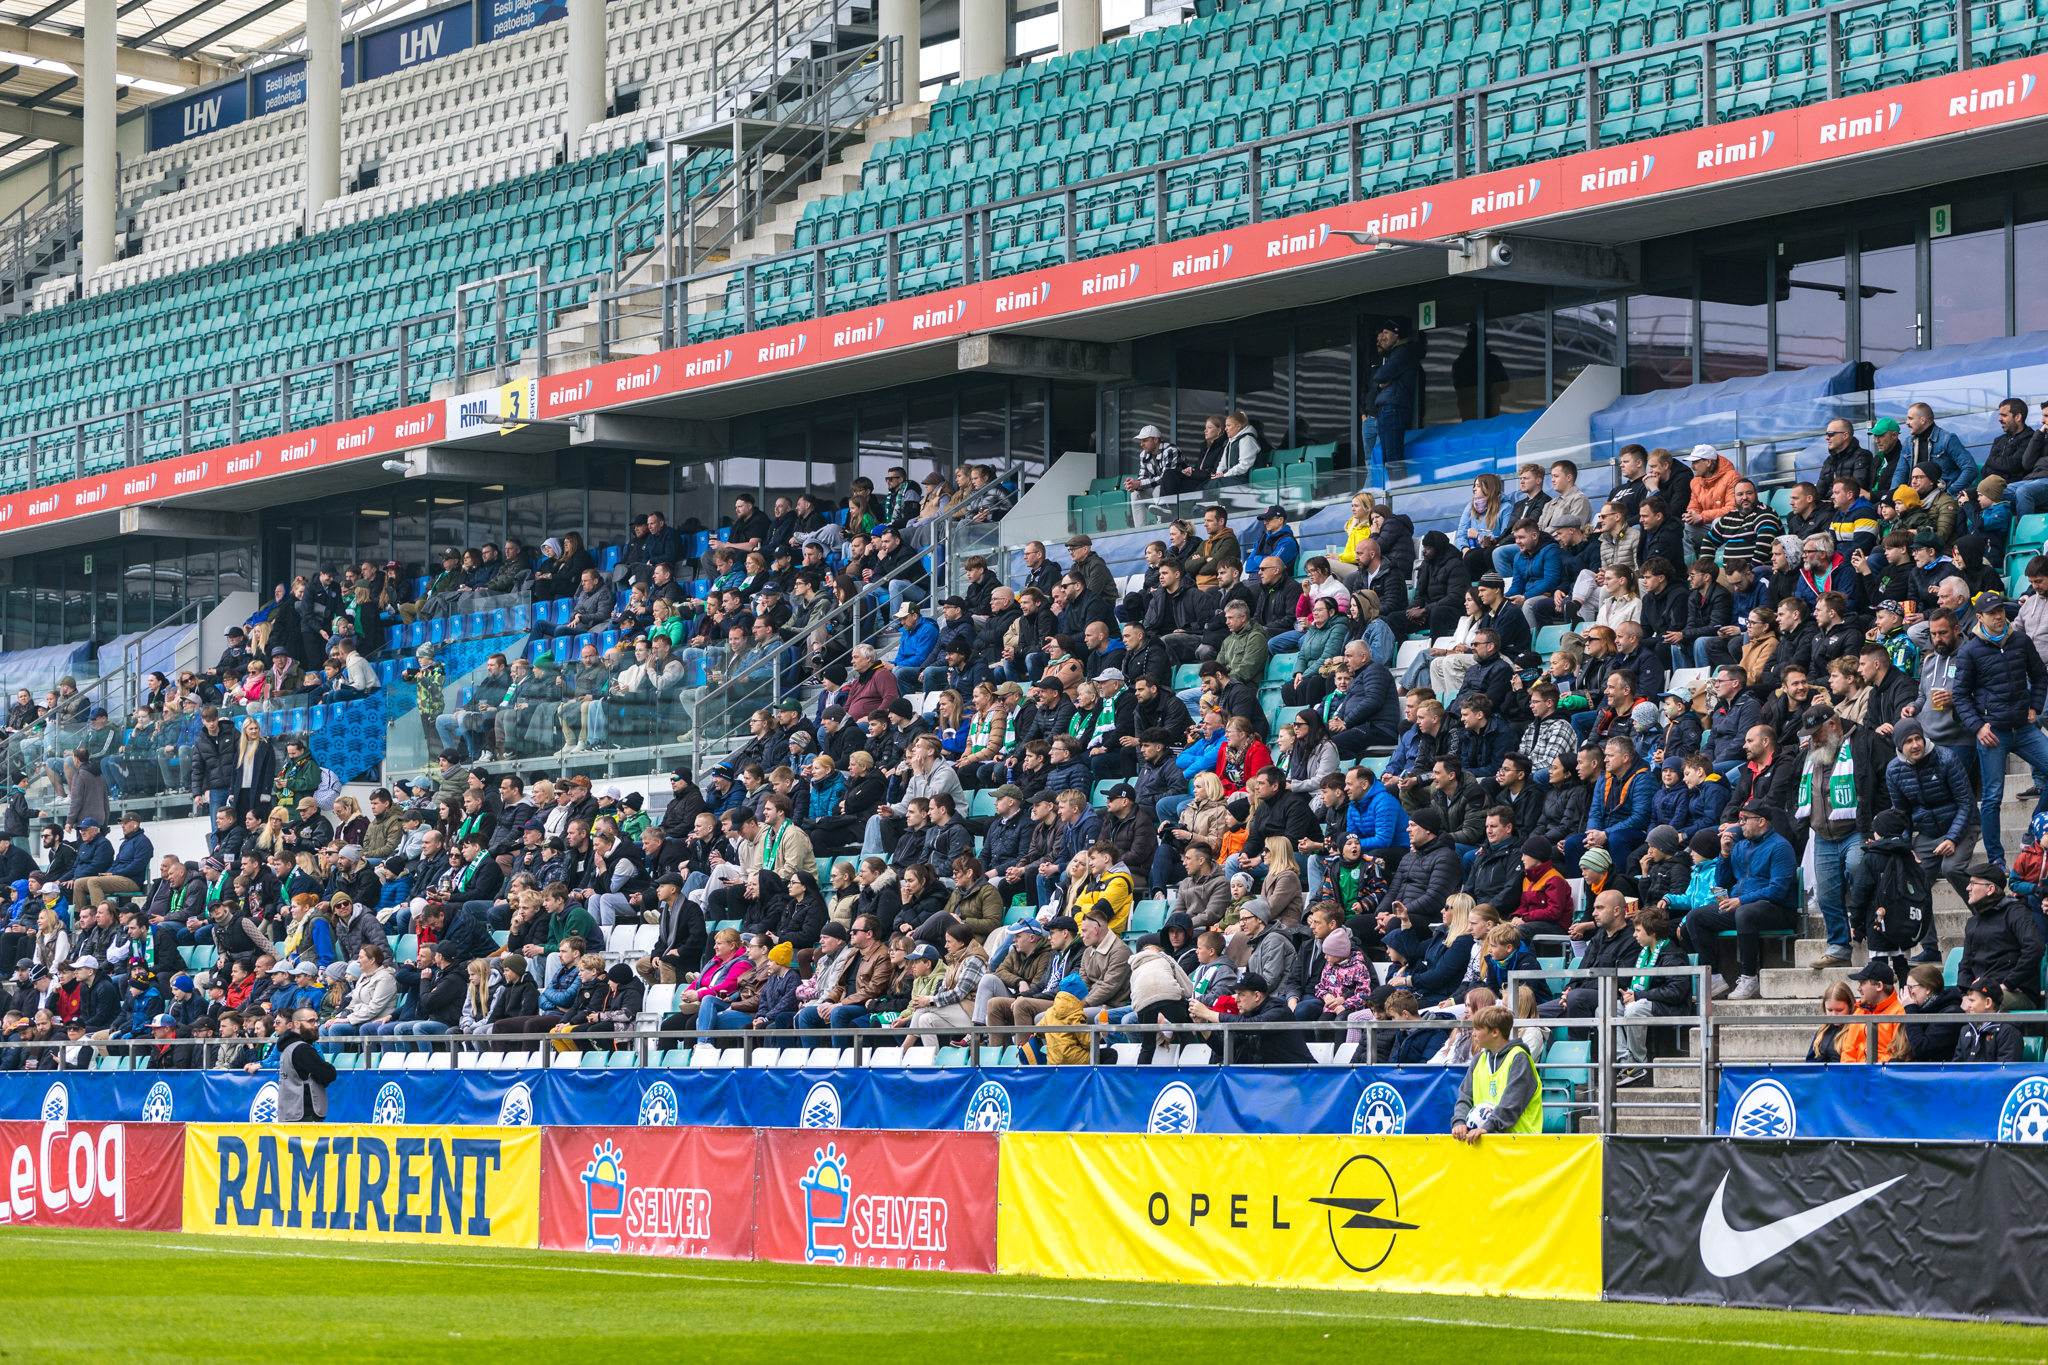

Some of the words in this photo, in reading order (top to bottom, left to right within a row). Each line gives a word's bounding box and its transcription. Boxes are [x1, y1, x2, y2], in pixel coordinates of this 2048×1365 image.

[494, 0, 513, 17] Eesti
[493, 10, 536, 38] peatoetaja
[400, 20, 444, 66] LHV
[266, 75, 283, 93] Eesti
[266, 87, 302, 112] peatoetaja
[1949, 81, 2016, 117] Rimi
[184, 95, 222, 136] LHV
[1820, 109, 1883, 145] Rimi
[1697, 136, 1757, 169] Rimi
[1581, 161, 1638, 193] Rimi
[1471, 184, 1525, 215] Rimi
[1367, 207, 1417, 236] Rimi
[1936, 209, 1946, 232] 9
[1267, 229, 1315, 258] Rimi
[1173, 249, 1219, 277] Rimi
[1082, 268, 1126, 296] Rimi
[996, 286, 1038, 313] Rimi
[913, 304, 954, 330] Rimi
[1423, 304, 1431, 326] 8
[834, 322, 874, 347] Rimi
[758, 338, 795, 362] Rimi
[686, 354, 721, 378] Rimi
[617, 368, 651, 392] Rimi
[550, 383, 583, 405] Rimi
[460, 400, 487, 429] RIMI
[509, 391, 520, 419] 3
[396, 417, 425, 438] Rimi
[281, 442, 309, 462] Rimi
[337, 430, 366, 450] Rimi
[174, 465, 200, 484] Rimi
[227, 454, 254, 474] Rimi
[76, 487, 100, 505] Rimi
[124, 476, 150, 495] Rimi
[29, 497, 53, 516] Rimi
[86, 557, 91, 571] 5
[1909, 906, 1923, 921] 50
[151, 1085, 169, 1098] EESTI
[381, 1086, 400, 1099] EESTI
[650, 1086, 671, 1100] EESTI
[978, 1086, 1004, 1101] EESTI
[1365, 1087, 1396, 1104] EESTI
[2016, 1083, 2048, 1103] EEST
[215, 1136, 501, 1237] RAMIRENT
[626, 1187, 712, 1240] SELVER
[852, 1194, 948, 1251] SELVER
[1148, 1191, 1291, 1230] OPEL
